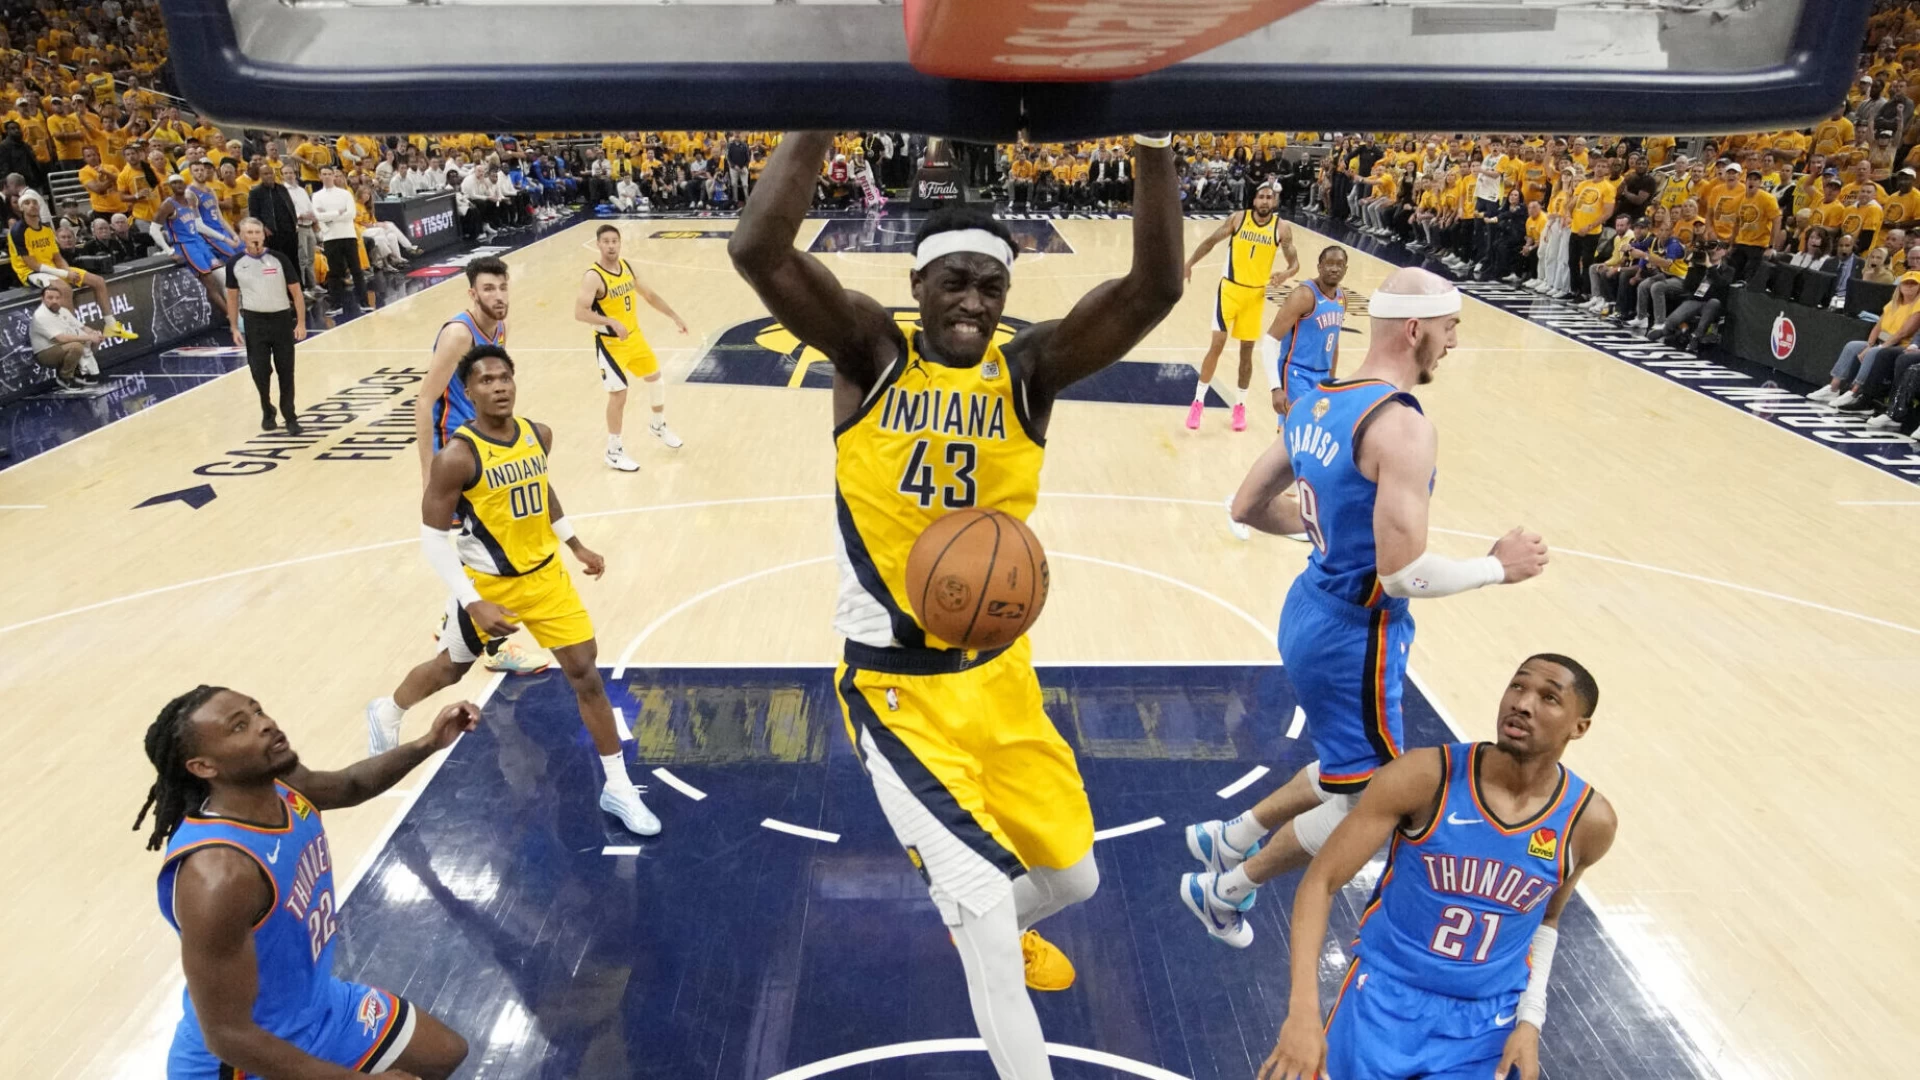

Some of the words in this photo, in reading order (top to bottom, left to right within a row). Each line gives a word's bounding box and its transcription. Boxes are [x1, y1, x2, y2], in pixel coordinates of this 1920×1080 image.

[421, 210, 454, 236] TISSOT
[1239, 229, 1273, 246] INDIANA
[1249, 244, 1256, 260] 1
[75, 293, 134, 324] FFIIAL
[608, 281, 636, 299] INDIAN
[624, 295, 631, 312] 9
[1325, 332, 1335, 352] 8
[193, 366, 429, 476] GAINBRIDGE
[880, 386, 1006, 440] INDIANA
[899, 440, 978, 509] 43
[511, 481, 543, 519] 00
[1298, 477, 1327, 556] 9
[1422, 853, 1553, 913] THUNDER
[306, 889, 337, 963] 22
[1431, 905, 1503, 963] 21
